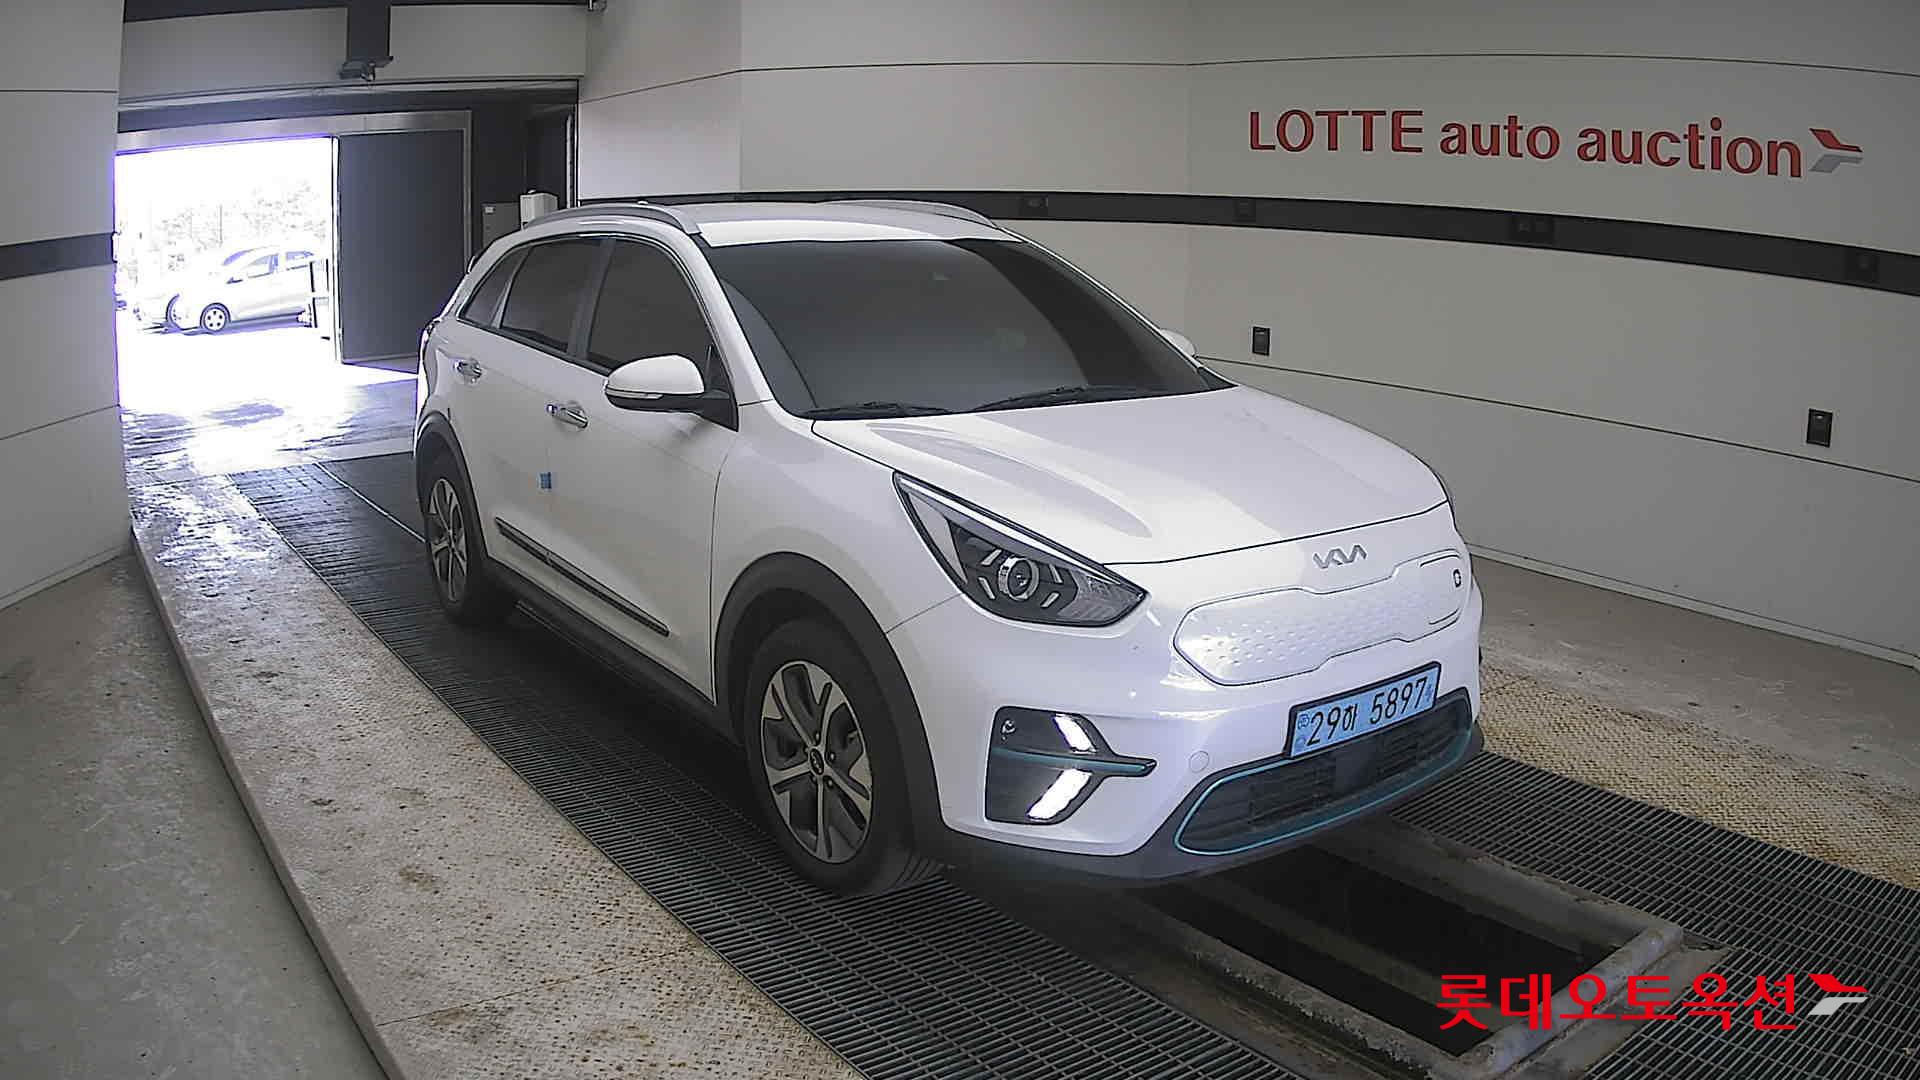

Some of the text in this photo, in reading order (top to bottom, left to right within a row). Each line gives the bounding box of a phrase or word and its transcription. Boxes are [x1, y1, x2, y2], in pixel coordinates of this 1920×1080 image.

[1248, 108, 1803, 179] LOTTE auto auction
[1369, 676, 1428, 725] 5897
